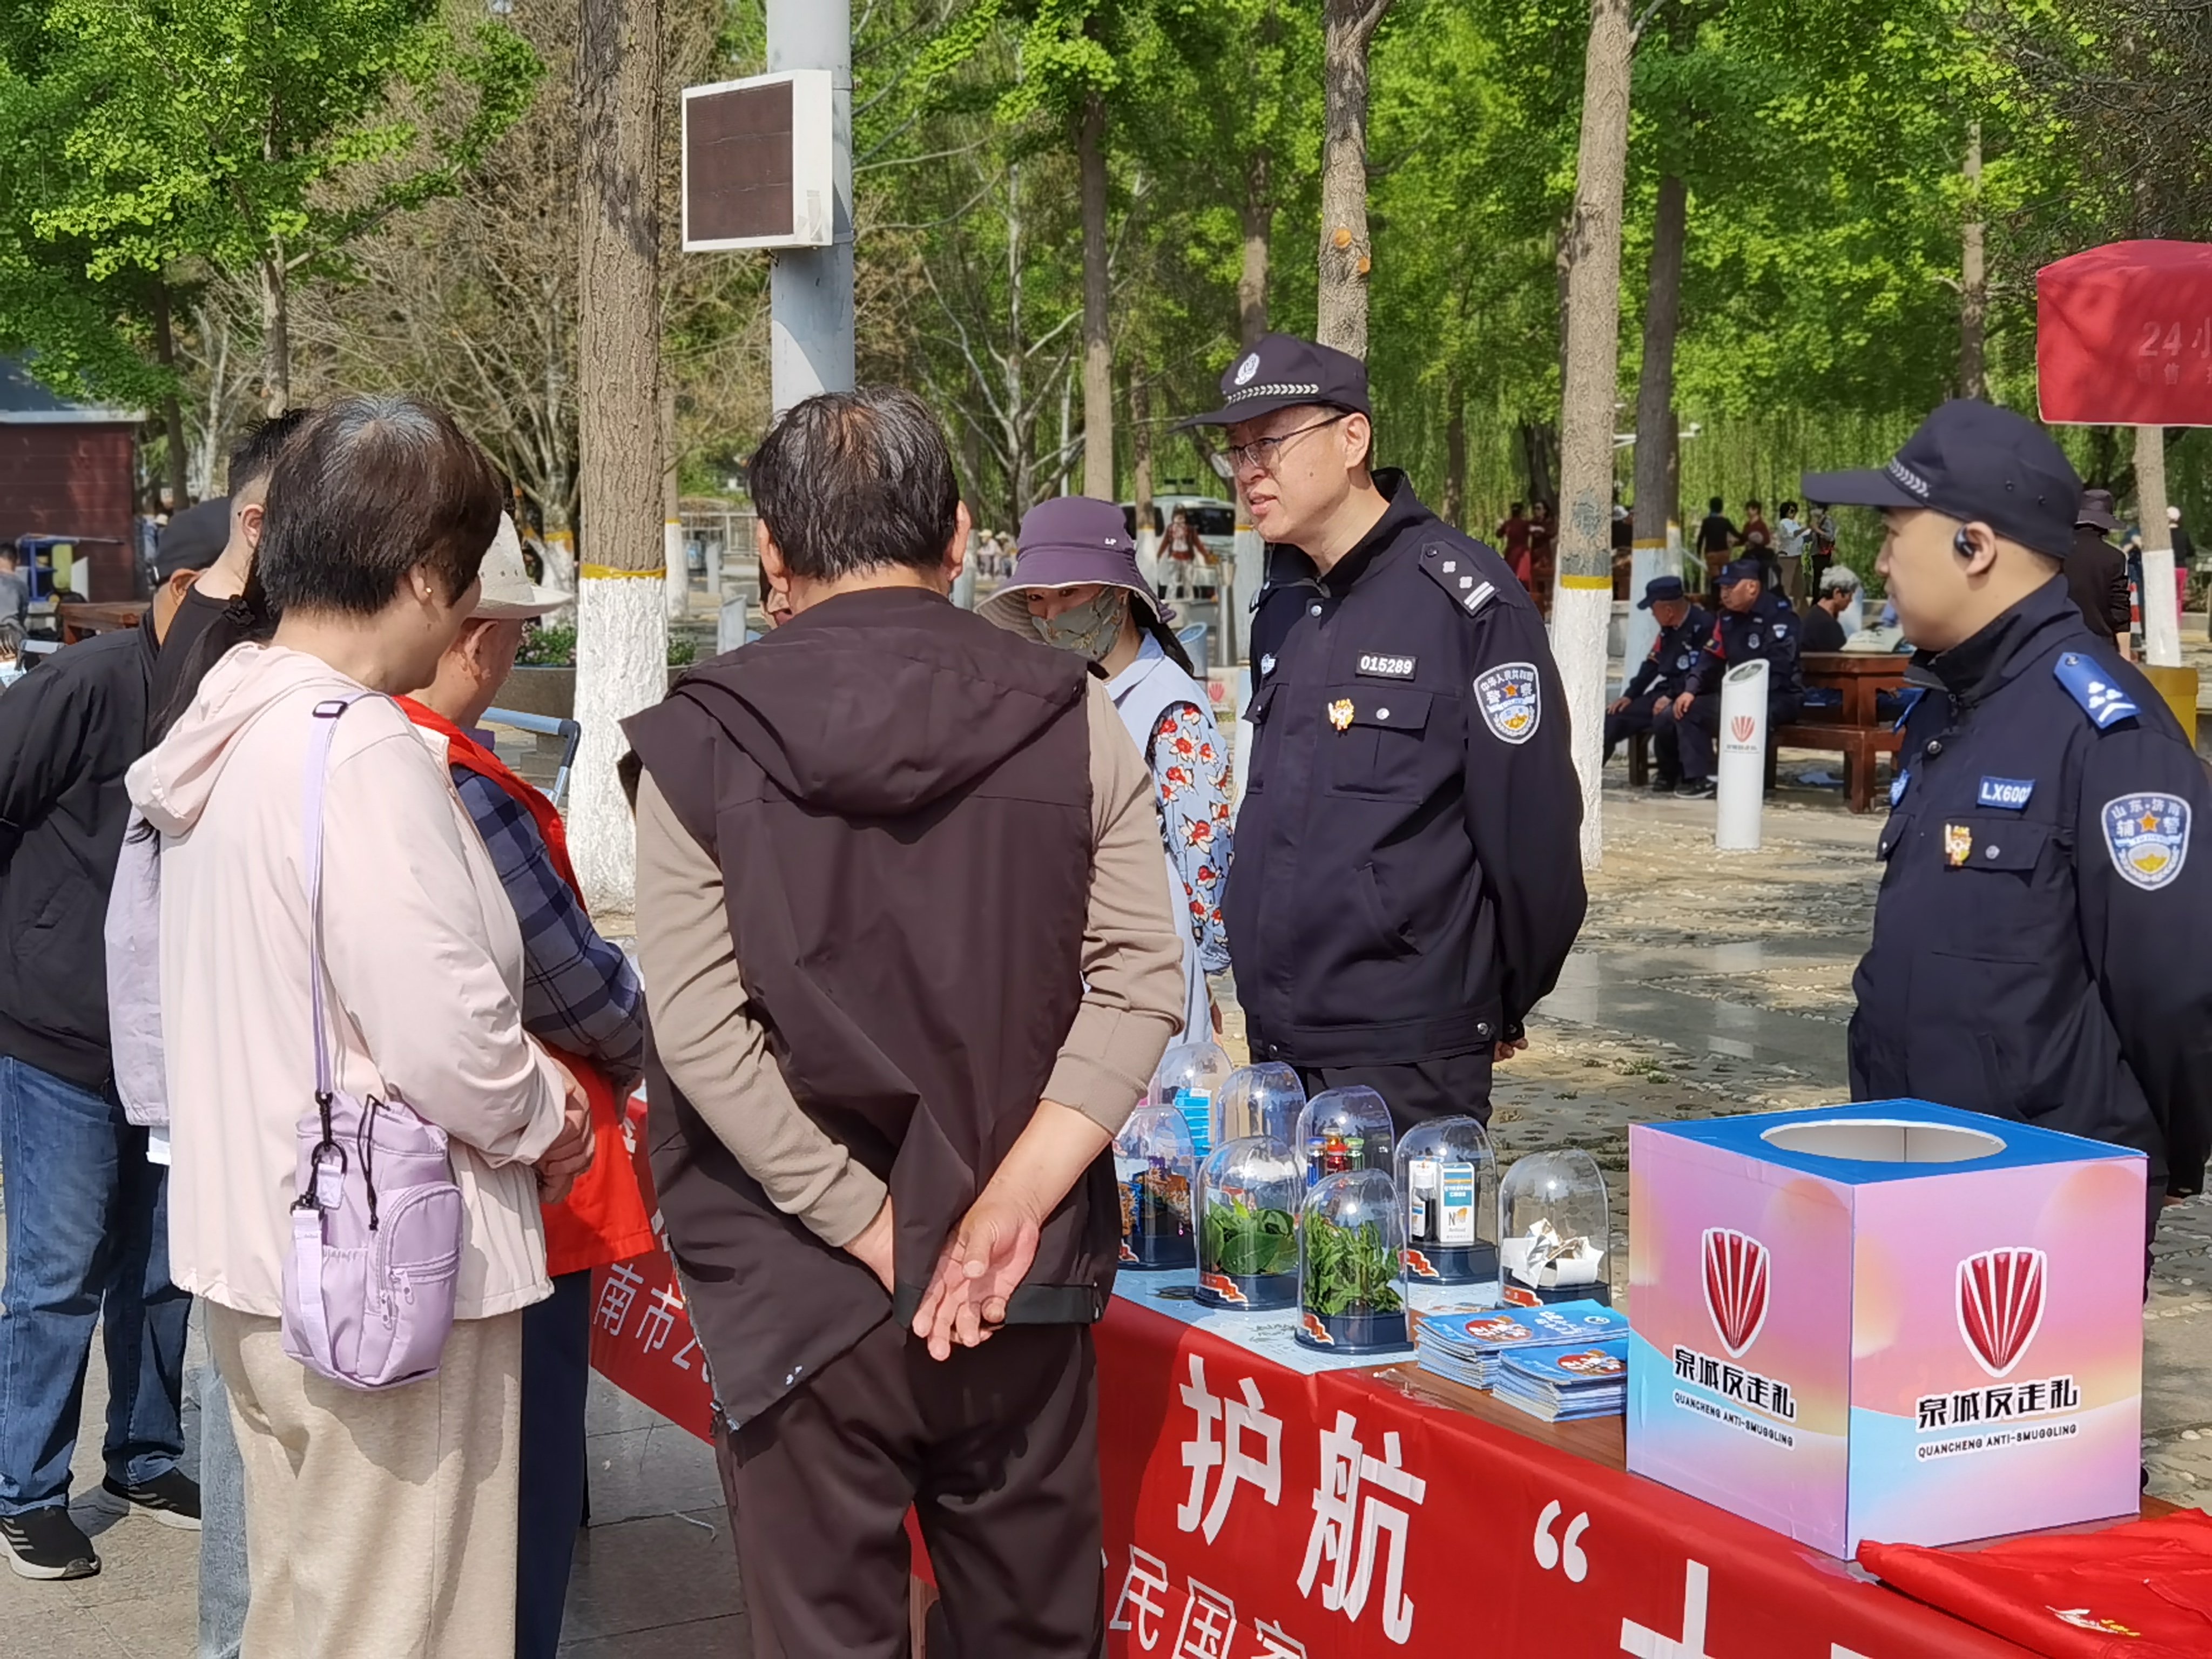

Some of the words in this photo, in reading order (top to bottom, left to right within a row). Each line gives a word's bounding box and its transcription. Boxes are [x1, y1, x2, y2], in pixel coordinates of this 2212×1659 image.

[1361, 655, 1412, 675] 015289
[1675, 1348, 1794, 1418] 泉城反走私
[1919, 1378, 2078, 1429] 泉城反走私
[1675, 1392, 1721, 1419] QUANCHENG
[1723, 1411, 1793, 1446] ANTI-SMUGGLING
[1918, 1438, 1983, 1458] QUANCHENG
[1986, 1424, 2077, 1447] ANTI-SMUGGLING
[1177, 1352, 1873, 1659] 护航“十
